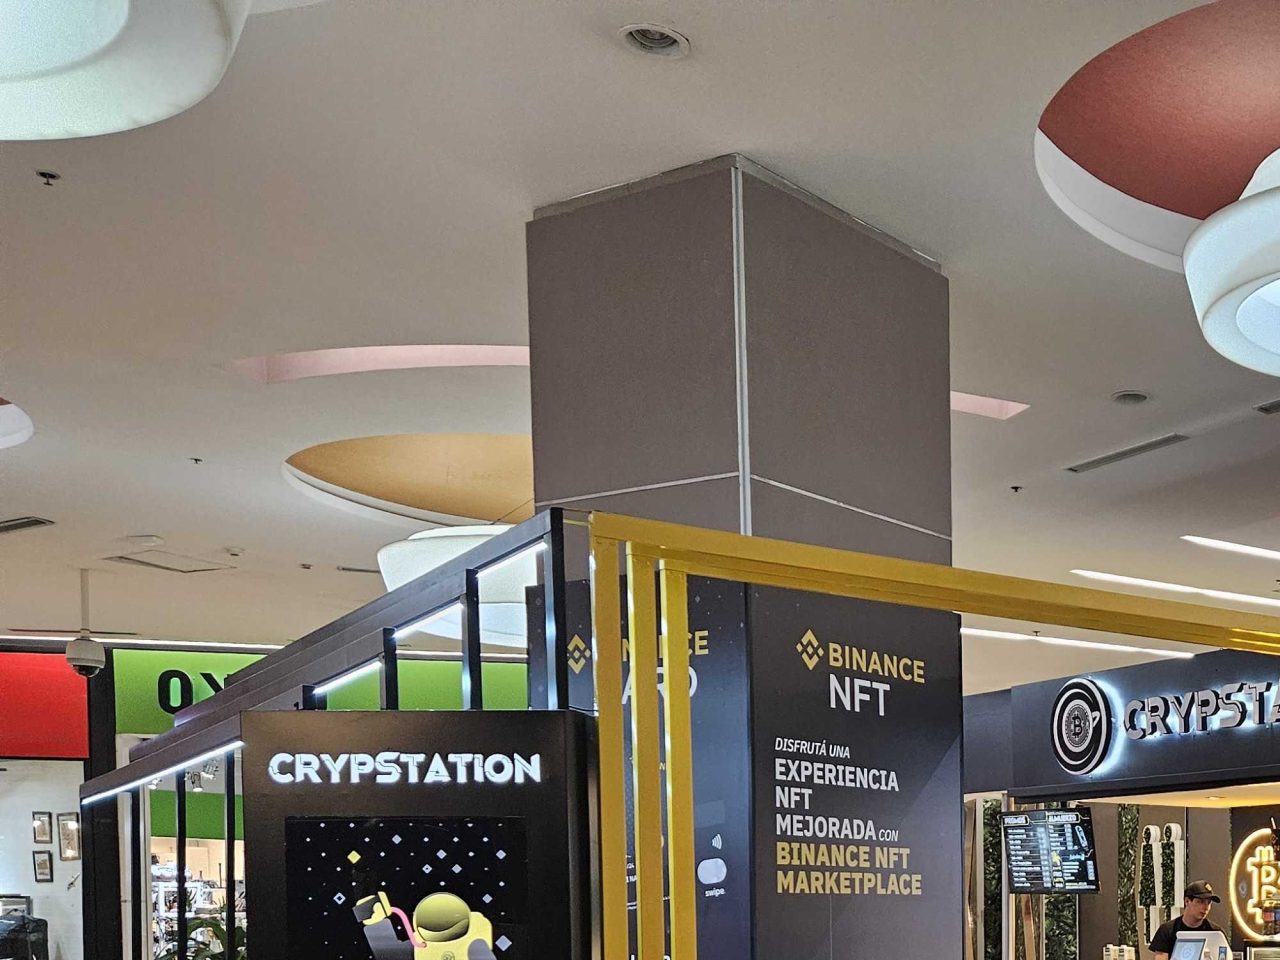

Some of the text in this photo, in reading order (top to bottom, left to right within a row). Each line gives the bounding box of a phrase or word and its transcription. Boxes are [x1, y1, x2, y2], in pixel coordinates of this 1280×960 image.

[828, 642, 926, 684] BINANCE
[829, 673, 891, 716] NFT
[775, 737, 850, 758] DISFRUTÁ UNA
[268, 751, 542, 784] CRYPSTATION
[775, 758, 899, 791] EXPERIENCIA
[775, 786, 812, 809] NFT
[776, 813, 899, 842] MEJORADA CON
[776, 841, 910, 869] BINANCE NFT
[776, 870, 922, 895] MARKETPLACE
